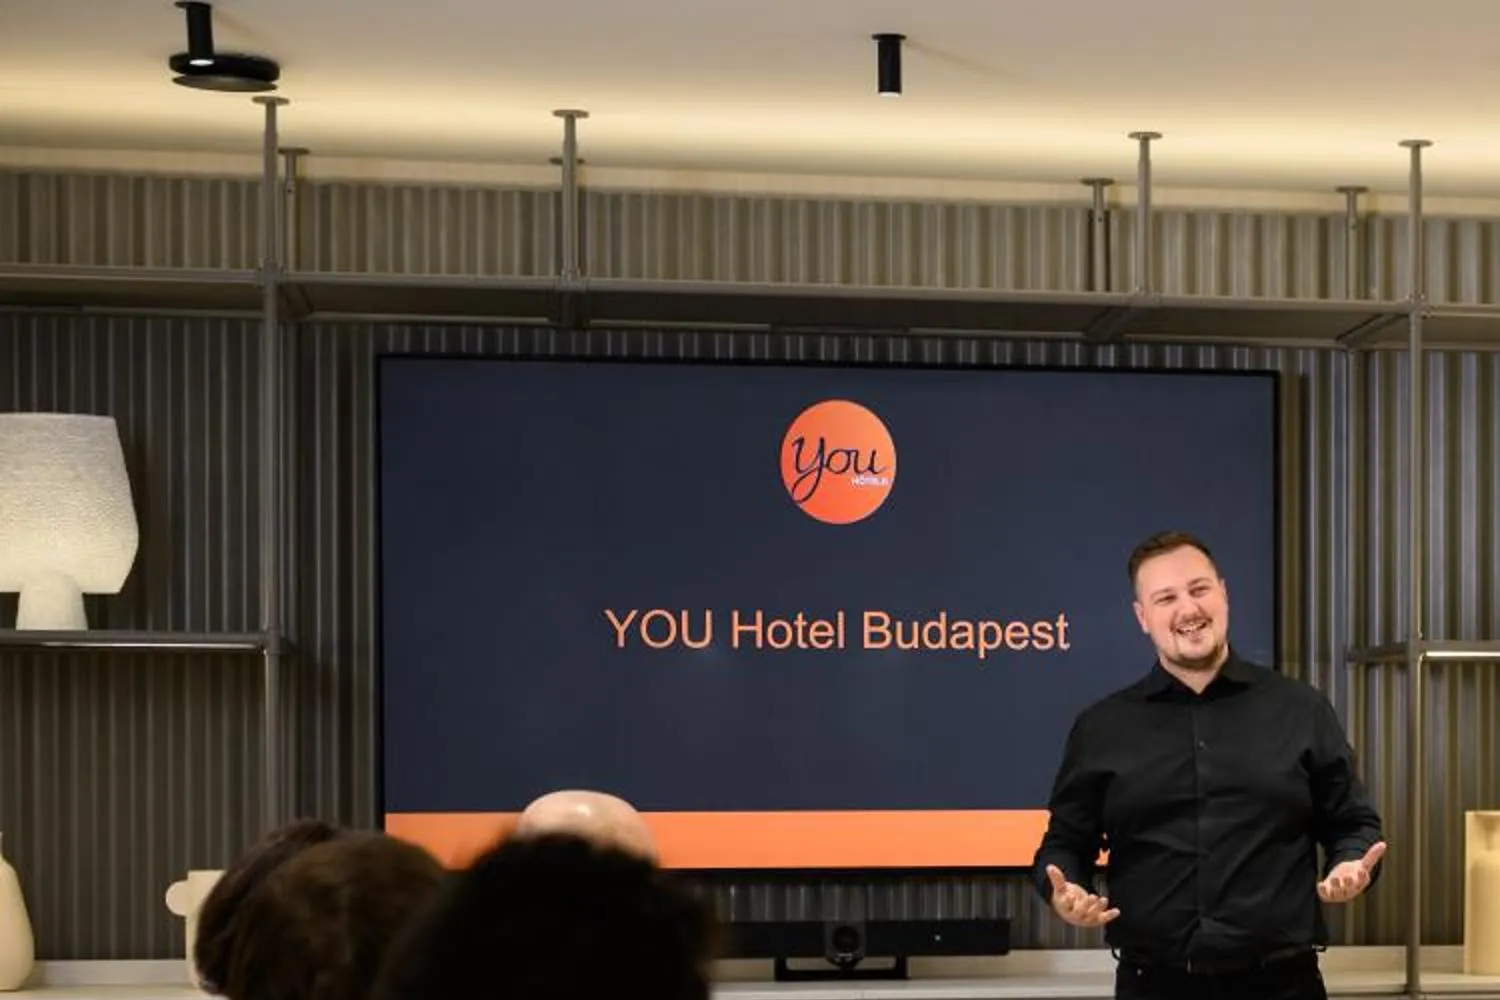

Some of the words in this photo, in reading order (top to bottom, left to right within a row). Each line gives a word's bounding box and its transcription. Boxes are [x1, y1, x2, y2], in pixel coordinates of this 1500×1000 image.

[604, 608, 713, 649] YOU
[731, 609, 845, 649] Hotel
[863, 610, 1071, 659] Budapest
